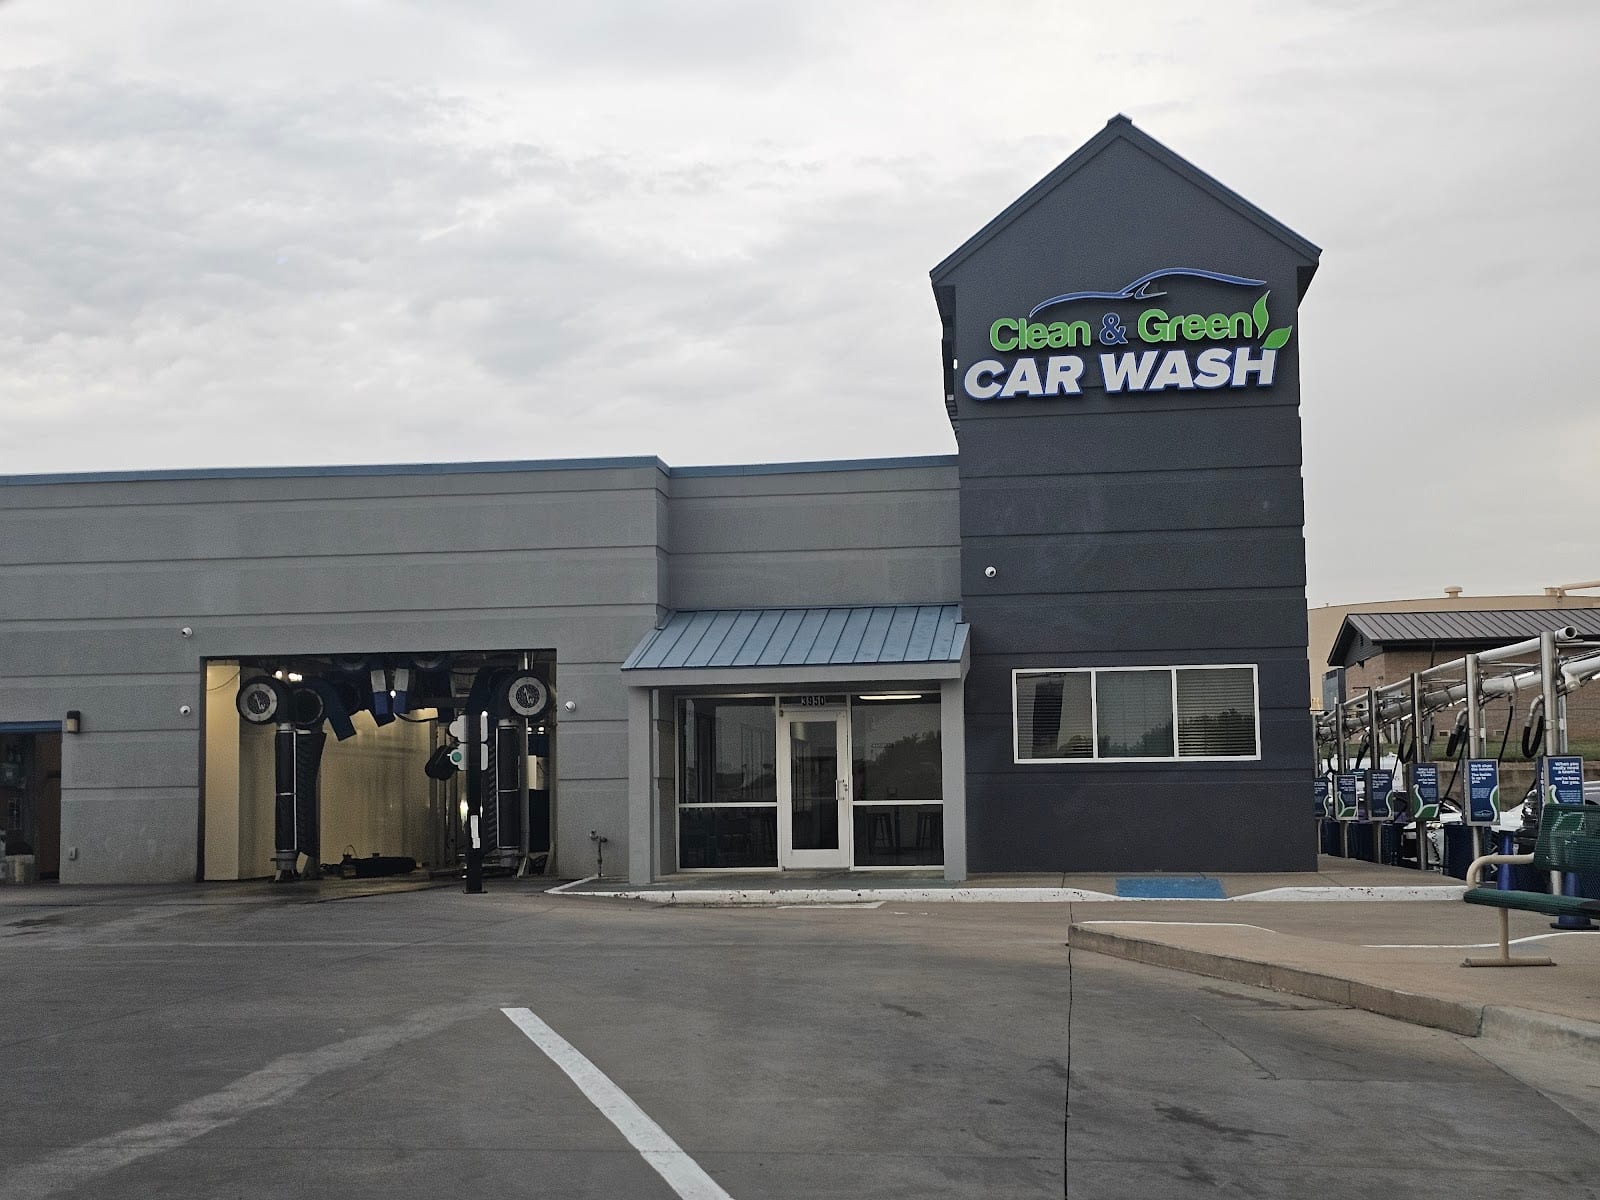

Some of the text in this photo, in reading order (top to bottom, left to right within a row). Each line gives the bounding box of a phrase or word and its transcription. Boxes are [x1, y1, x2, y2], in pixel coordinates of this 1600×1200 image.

[989, 308, 1252, 351] Clean & Green
[963, 347, 1278, 400] CAR WASH
[801, 695, 826, 706] 3950
